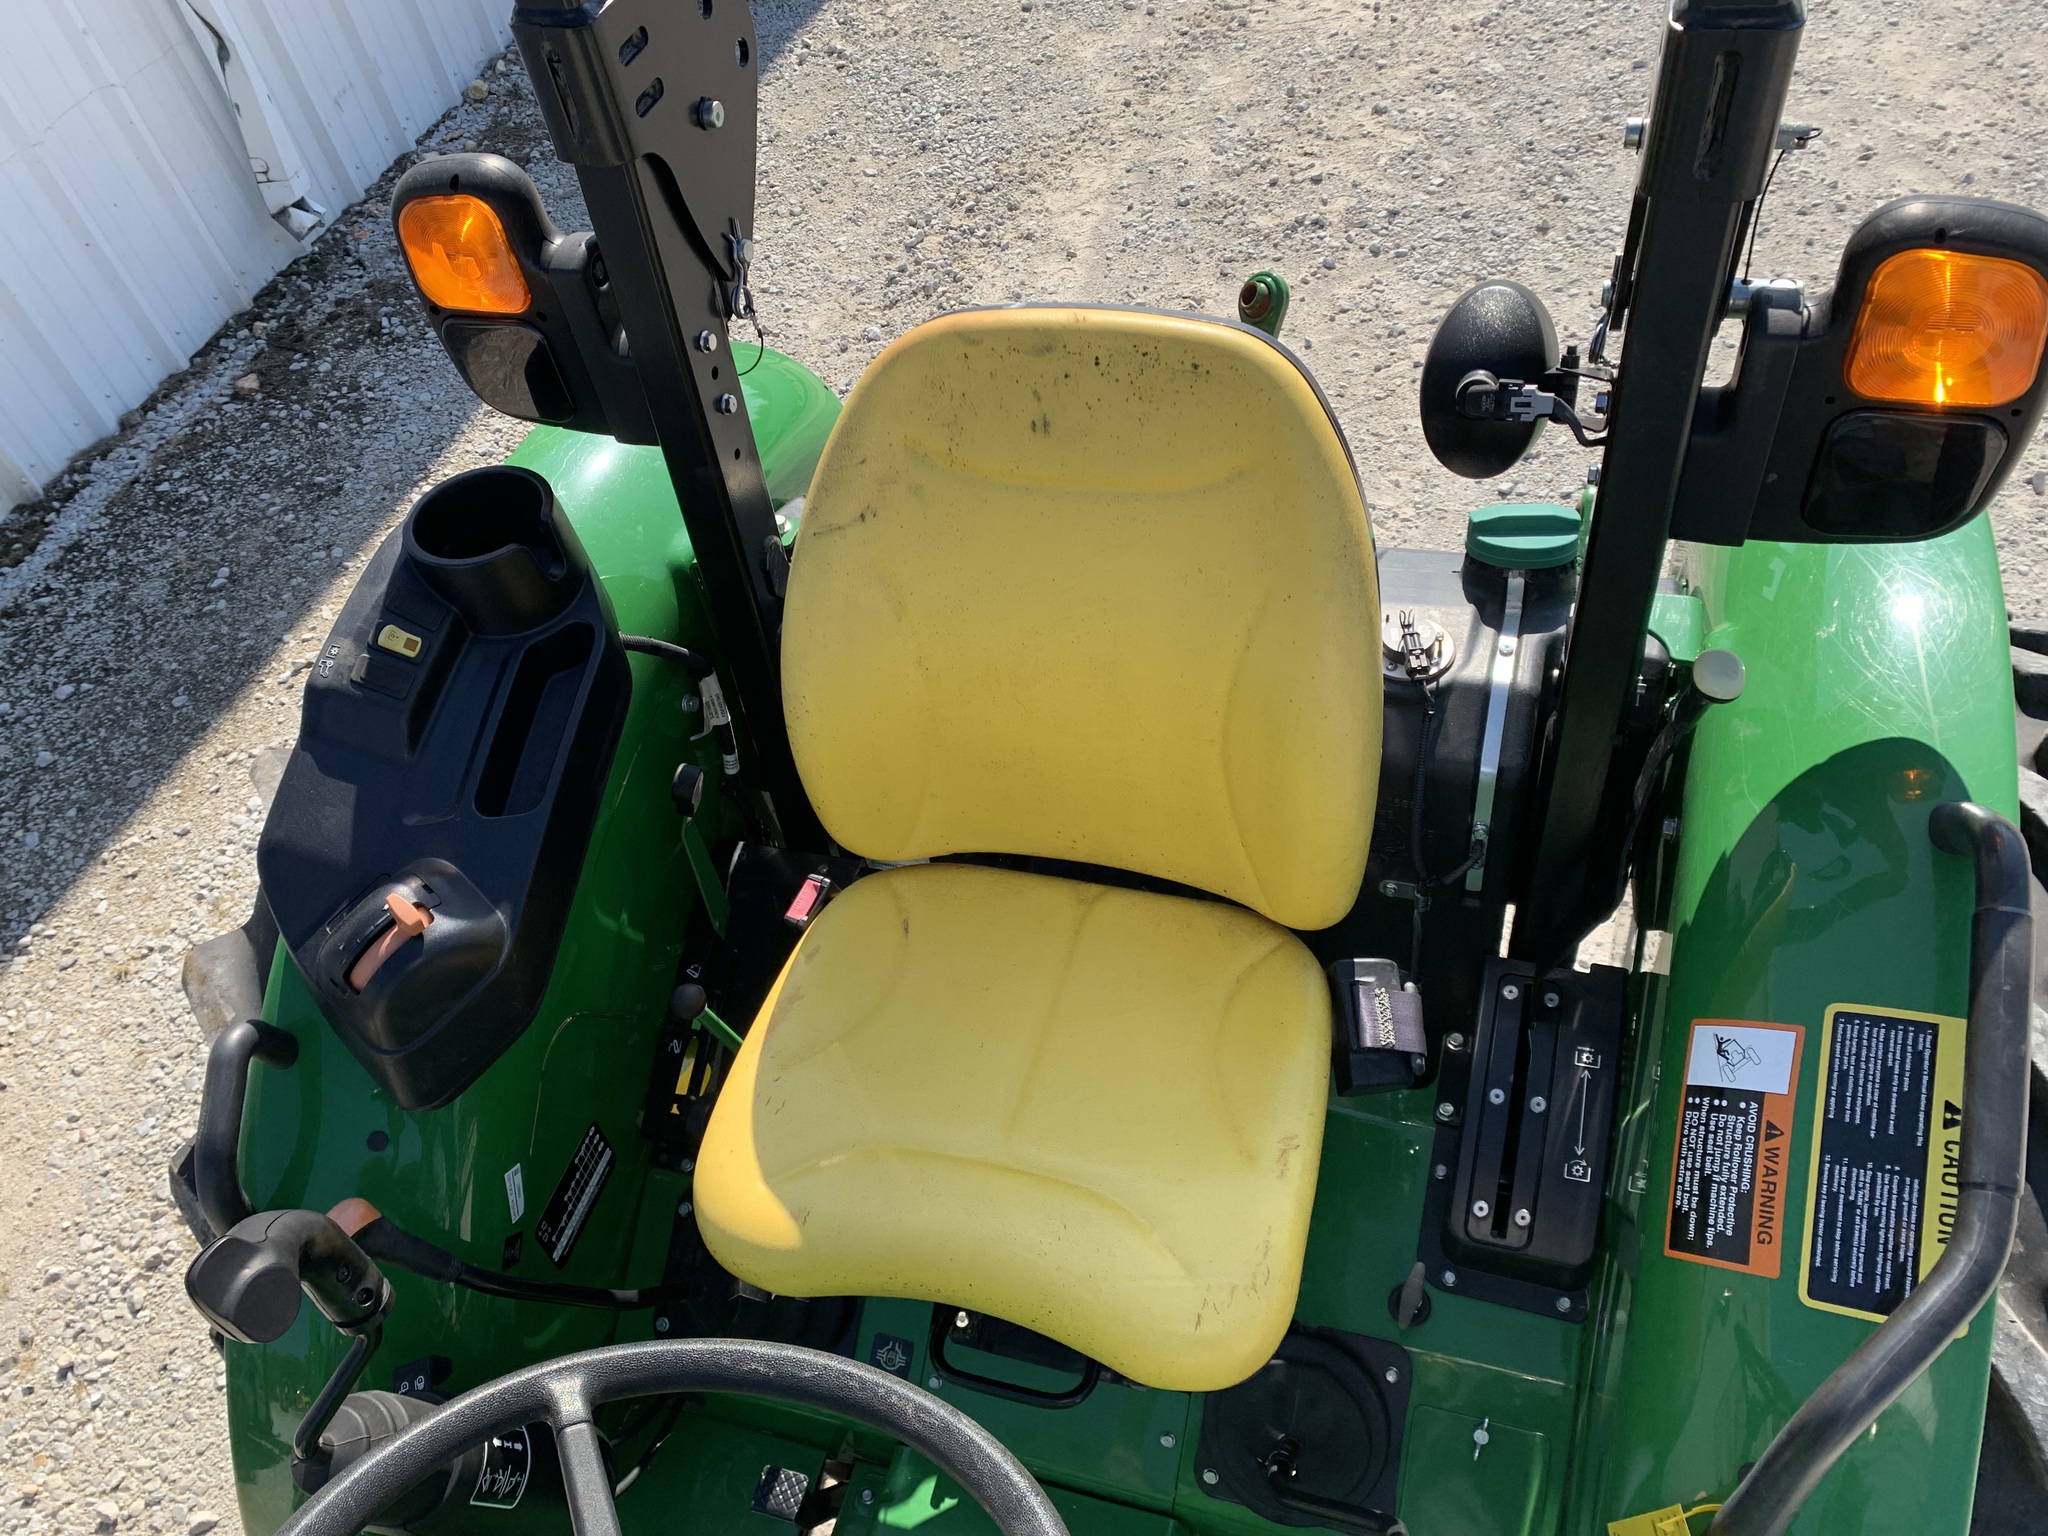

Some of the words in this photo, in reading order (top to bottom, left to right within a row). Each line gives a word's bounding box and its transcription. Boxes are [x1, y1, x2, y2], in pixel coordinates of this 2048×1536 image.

[1691, 1111, 1699, 1126] DO
[1699, 1096, 1709, 1123] When
[1718, 1114, 1726, 1127] Do
[1746, 1101, 1758, 1132] AVOID
[1683, 1110, 1692, 1135] Drive
[1708, 1113, 1718, 1131] Use
[1733, 1116, 1745, 1140] Keep
[1680, 1137, 1688, 1156] with
[1688, 1128, 1697, 1148] NOT
[1694, 1125, 1705, 1168] structure
[1706, 1133, 1716, 1154] seat
[1716, 1129, 1724, 1145] not
[1723, 1114, 1736, 1159] Structure
[1677, 1158, 1686, 1182] extra
[1703, 1156, 1713, 1176] belt.
[1711, 1147, 1723, 1172] jump
[1729, 1143, 1742, 1184] Rollover
[1739, 1135, 1754, 1193] CRUSHING:
[1683, 1170, 1692, 1190] seat
[1691, 1170, 1701, 1194] must
[1719, 1161, 1730, 1183] fully
[1674, 1184, 1682, 1208] care.
[1681, 1192, 1689, 1213] belt.
[1690, 1196, 1698, 1209] be
[1707, 1183, 1720, 1225] machine
[1756, 1146, 1781, 1246] WARNING
[1715, 1184, 1728, 1233] extended.
[1724, 1186, 1738, 1236] Protective
[1704, 1226, 1714, 1248] tips.
